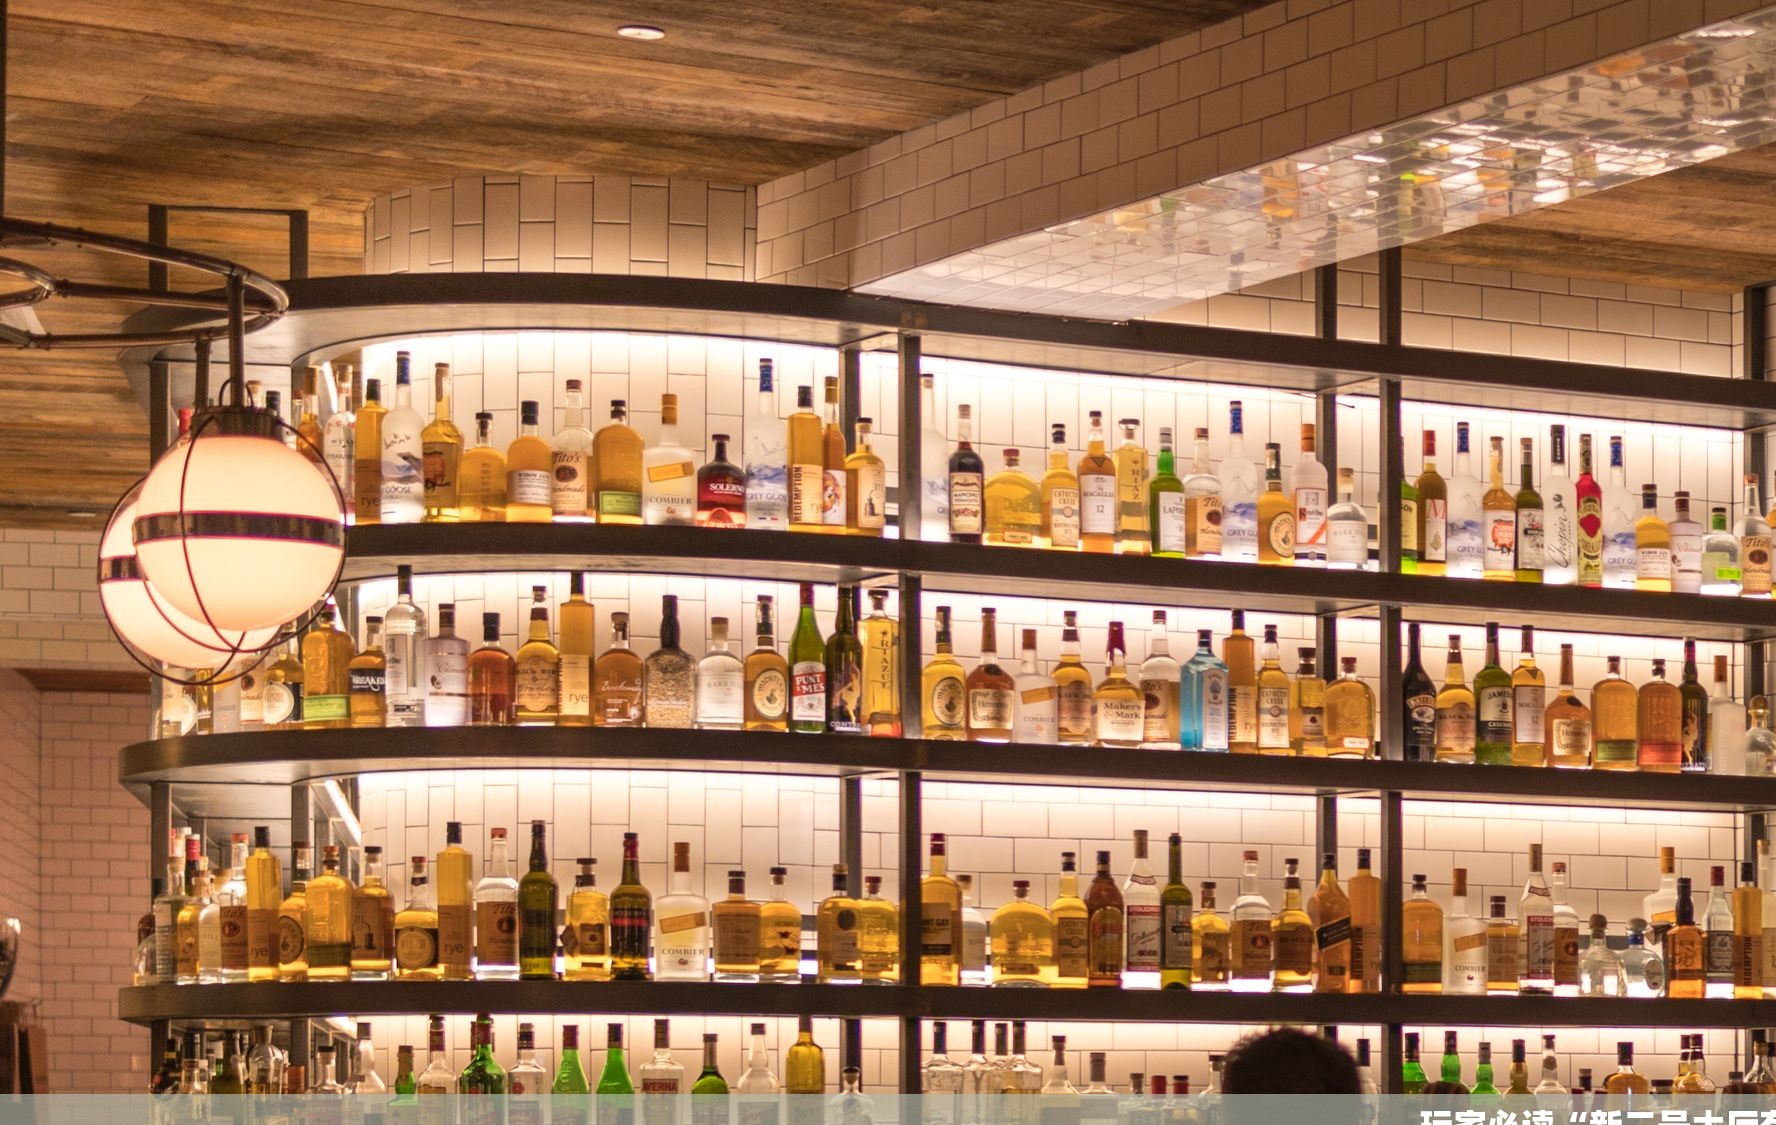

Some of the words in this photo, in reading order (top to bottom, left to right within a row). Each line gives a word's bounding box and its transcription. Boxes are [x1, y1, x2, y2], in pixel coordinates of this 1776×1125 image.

[793, 466, 803, 522] REDEMPTION
[650, 496, 692, 505] COMBIER
[1096, 504, 1105, 514] 12
[1227, 528, 1248, 537] GREY
[1547, 512, 1570, 570] Chopin
[1457, 545, 1475, 553] GREY
[1608, 556, 1628, 565] GREY
[796, 672, 822, 686] PUNT
[802, 683, 825, 694] MES
[569, 692, 588, 704] rye
[1104, 701, 1142, 712] Maker's
[1115, 710, 1141, 720] Mark
[444, 942, 464, 955] rye
[662, 948, 705, 956] COMBIER
[1743, 936, 1753, 985] REDEMPTION
[1455, 964, 1486, 973] COMBIER
[642, 1081, 679, 1092] AVERNA
